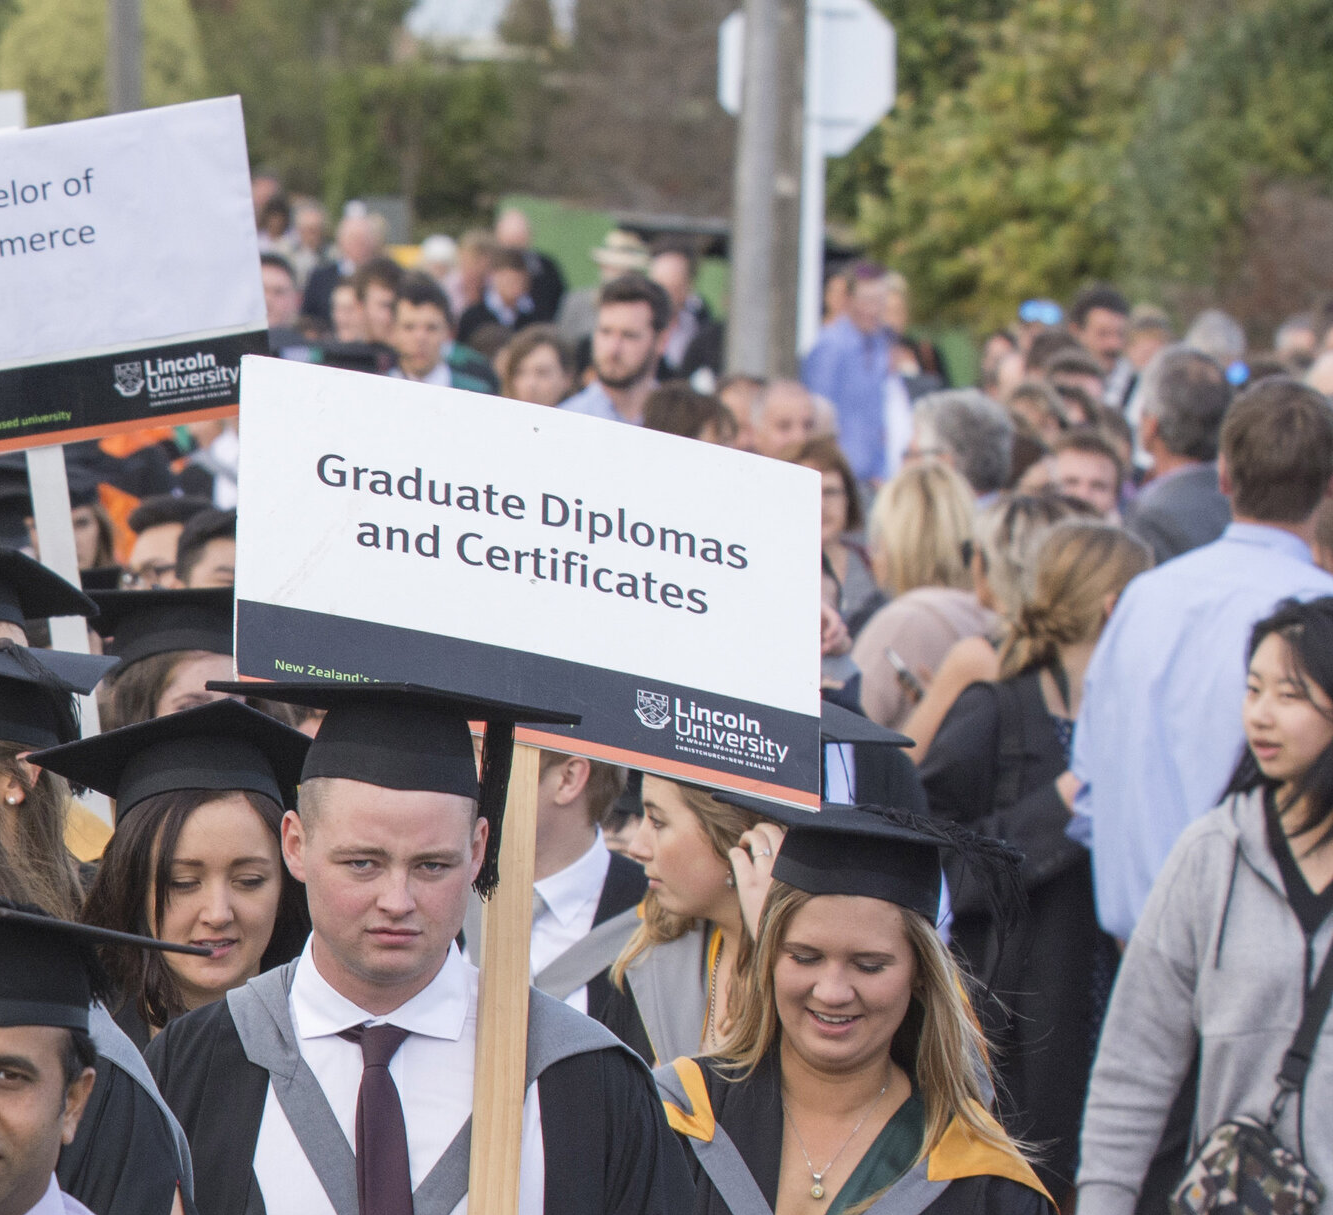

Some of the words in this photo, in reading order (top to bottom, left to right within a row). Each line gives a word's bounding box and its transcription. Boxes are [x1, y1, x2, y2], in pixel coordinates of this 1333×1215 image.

[64, 168, 94, 196] of
[145, 352, 215, 376] Lincoln
[147, 366, 239, 392] University
[21, 412, 71, 426] university
[317, 454, 525, 519] Graduate
[542, 493, 747, 569] Diplomas
[357, 523, 439, 558] and
[457, 533, 707, 614] Certificates
[275, 660, 304, 674] New
[675, 698, 761, 734] Lincoln
[675, 716, 789, 763] University
